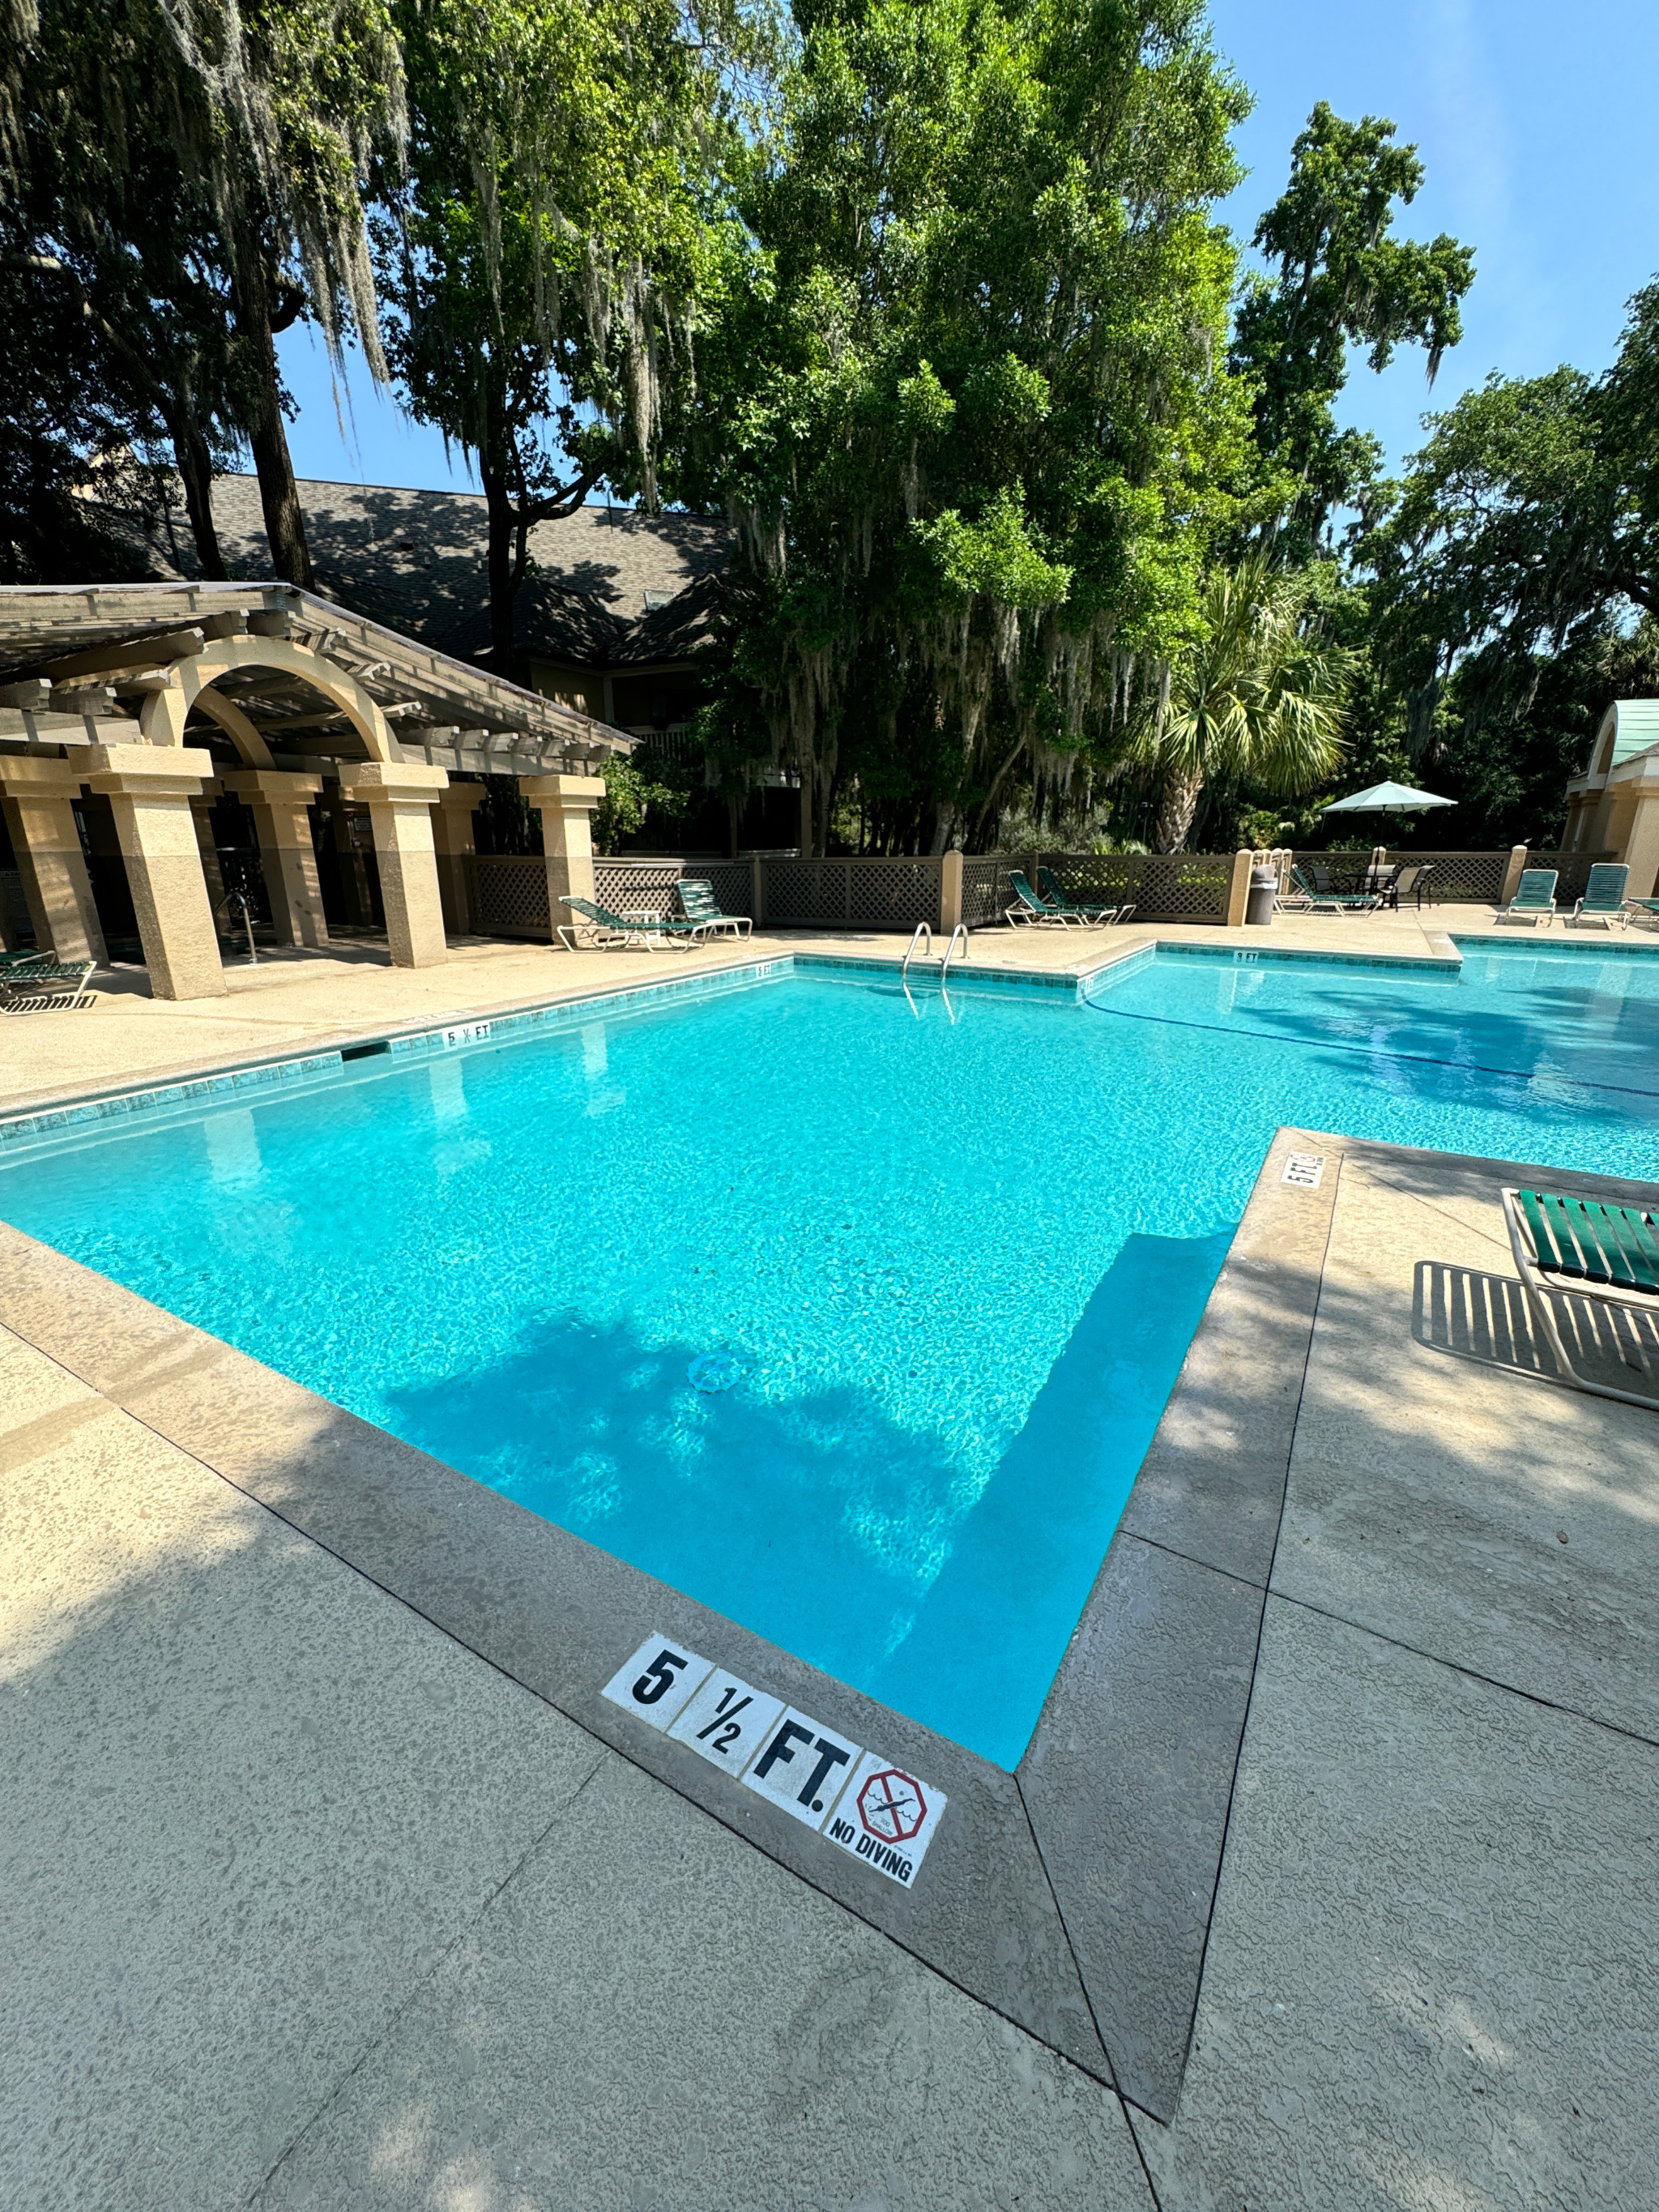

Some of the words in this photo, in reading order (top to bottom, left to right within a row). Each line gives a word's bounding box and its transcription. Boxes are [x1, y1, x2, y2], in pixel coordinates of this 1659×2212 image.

[1287, 1175, 1314, 1184] 5
[632, 1649, 689, 1705] 5
[753, 1719, 851, 1812] FT.
[872, 1821, 893, 1836] SHALLOW
[880, 1817, 891, 1827] TOO
[829, 1817, 855, 1844] NO
[855, 1833, 913, 1882] DIVING
